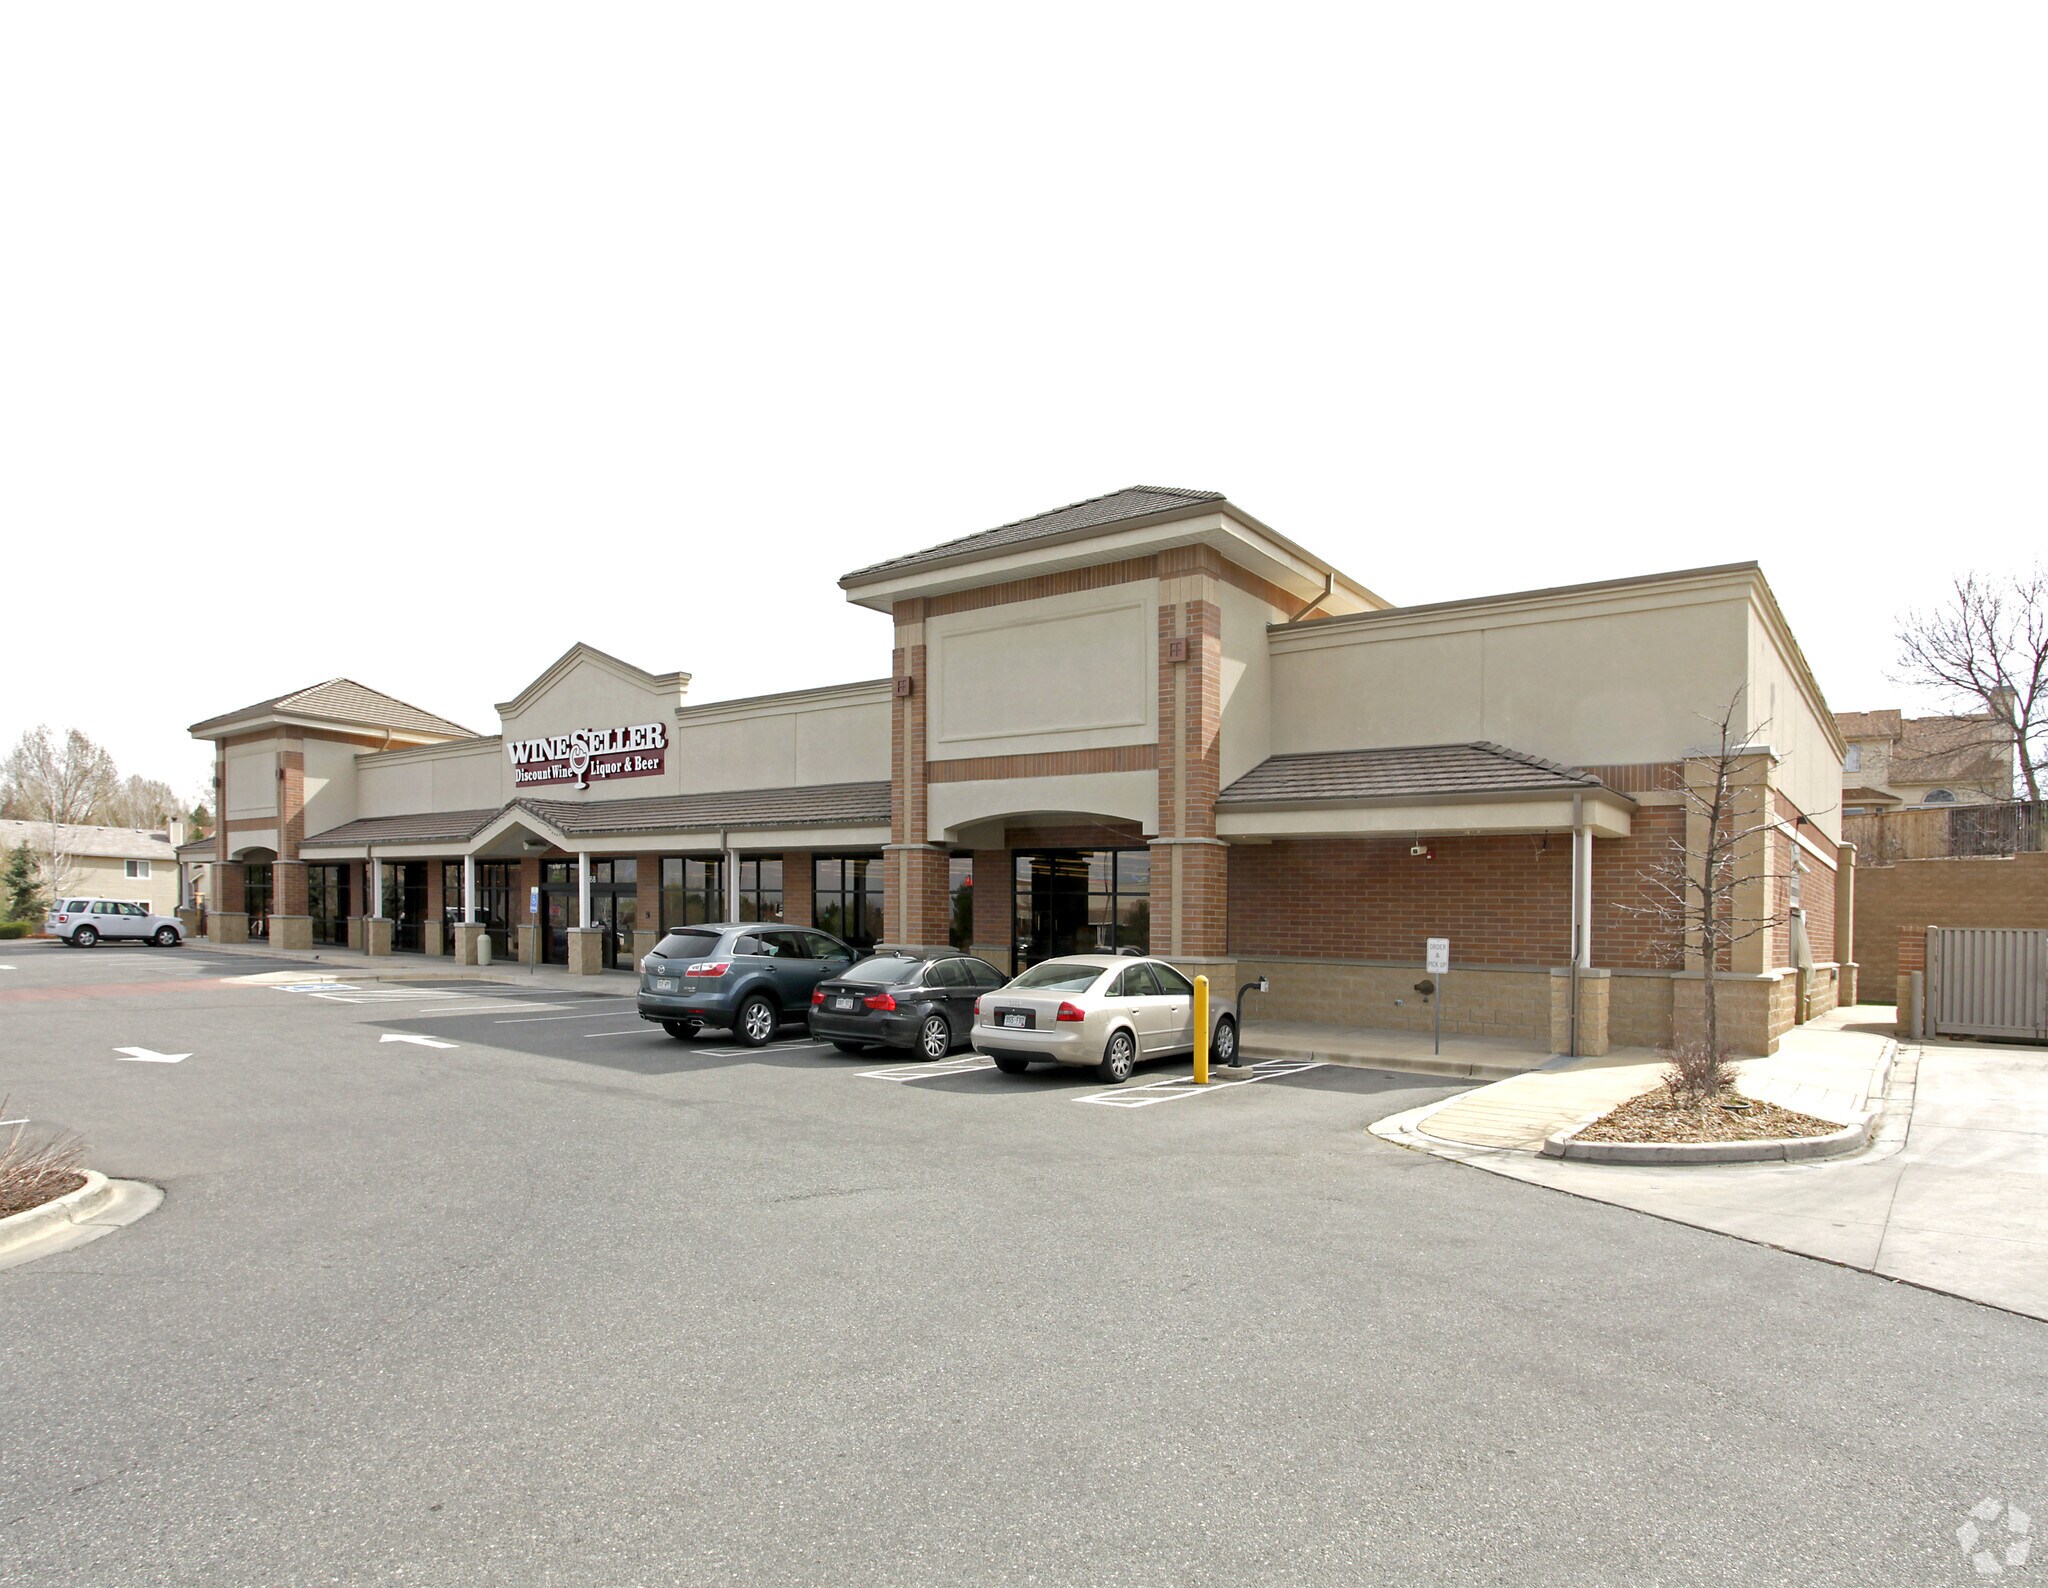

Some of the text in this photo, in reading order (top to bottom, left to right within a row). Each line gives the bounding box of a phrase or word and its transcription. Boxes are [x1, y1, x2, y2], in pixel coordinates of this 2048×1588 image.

[515, 755, 659, 783] Discount Wine Liquor & Beer
[1429, 943, 1447, 951] ORDER
